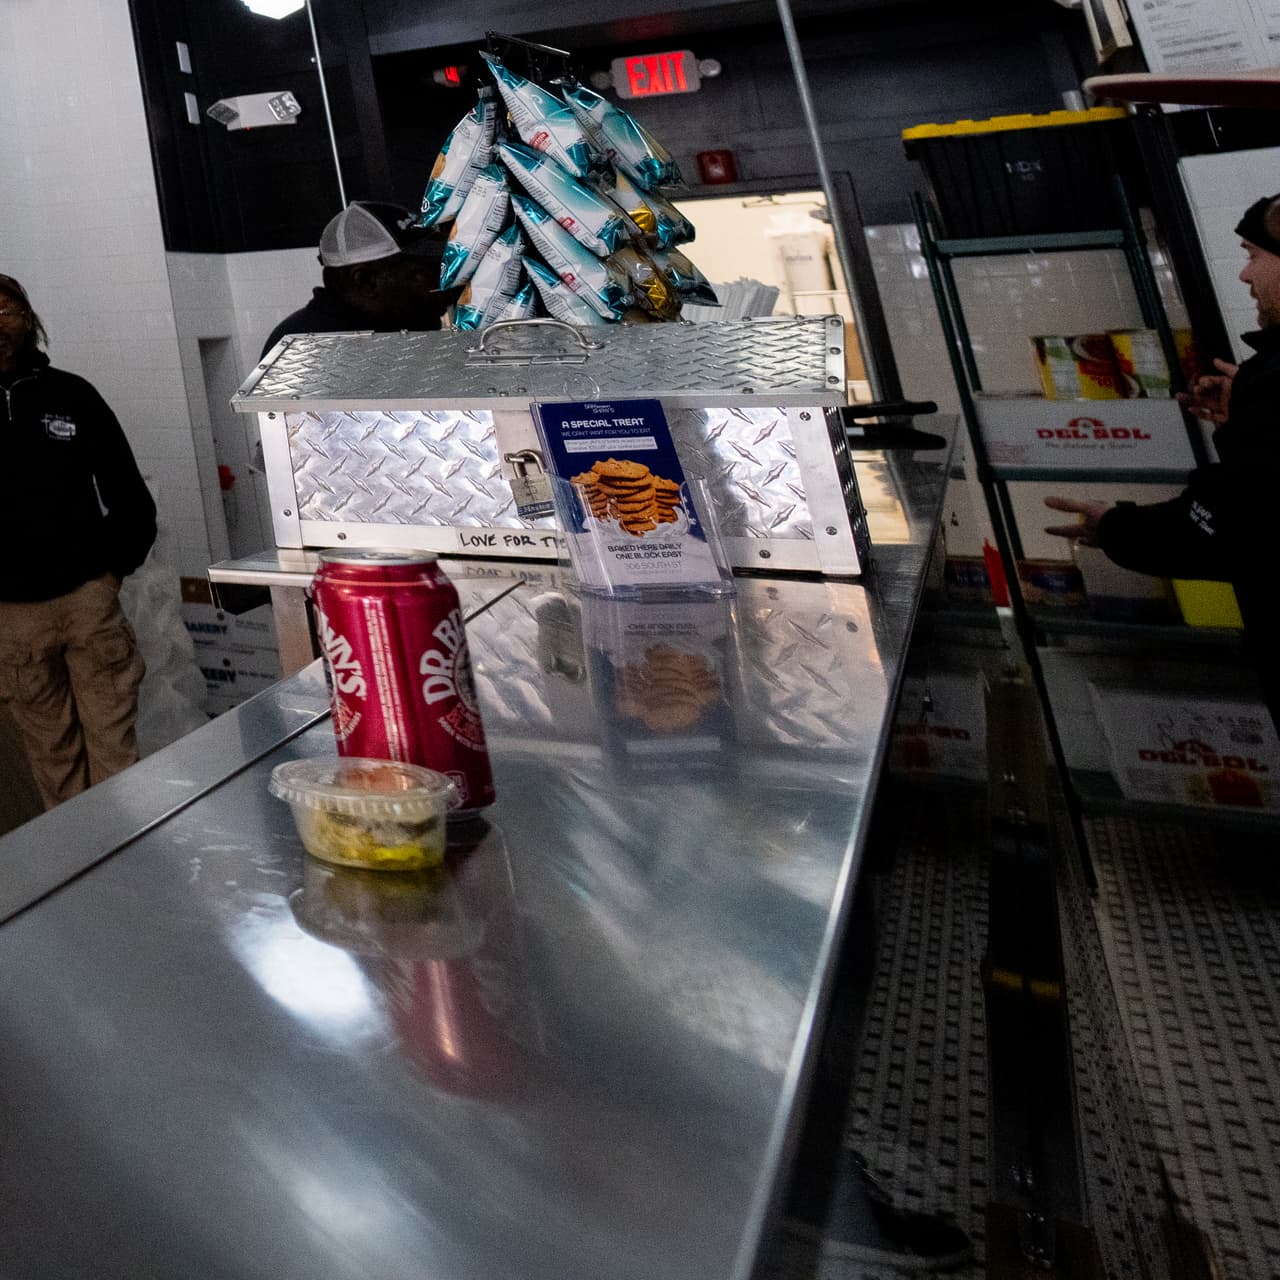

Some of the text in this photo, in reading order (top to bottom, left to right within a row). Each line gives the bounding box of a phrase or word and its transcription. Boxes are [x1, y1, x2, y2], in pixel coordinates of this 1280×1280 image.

[625, 52, 688, 96] EXIT
[571, 420, 612, 428] SPECIAL
[614, 418, 644, 426] TREAT
[459, 531, 536, 548] LOVE FOR
[659, 543, 682, 551] DAILY
